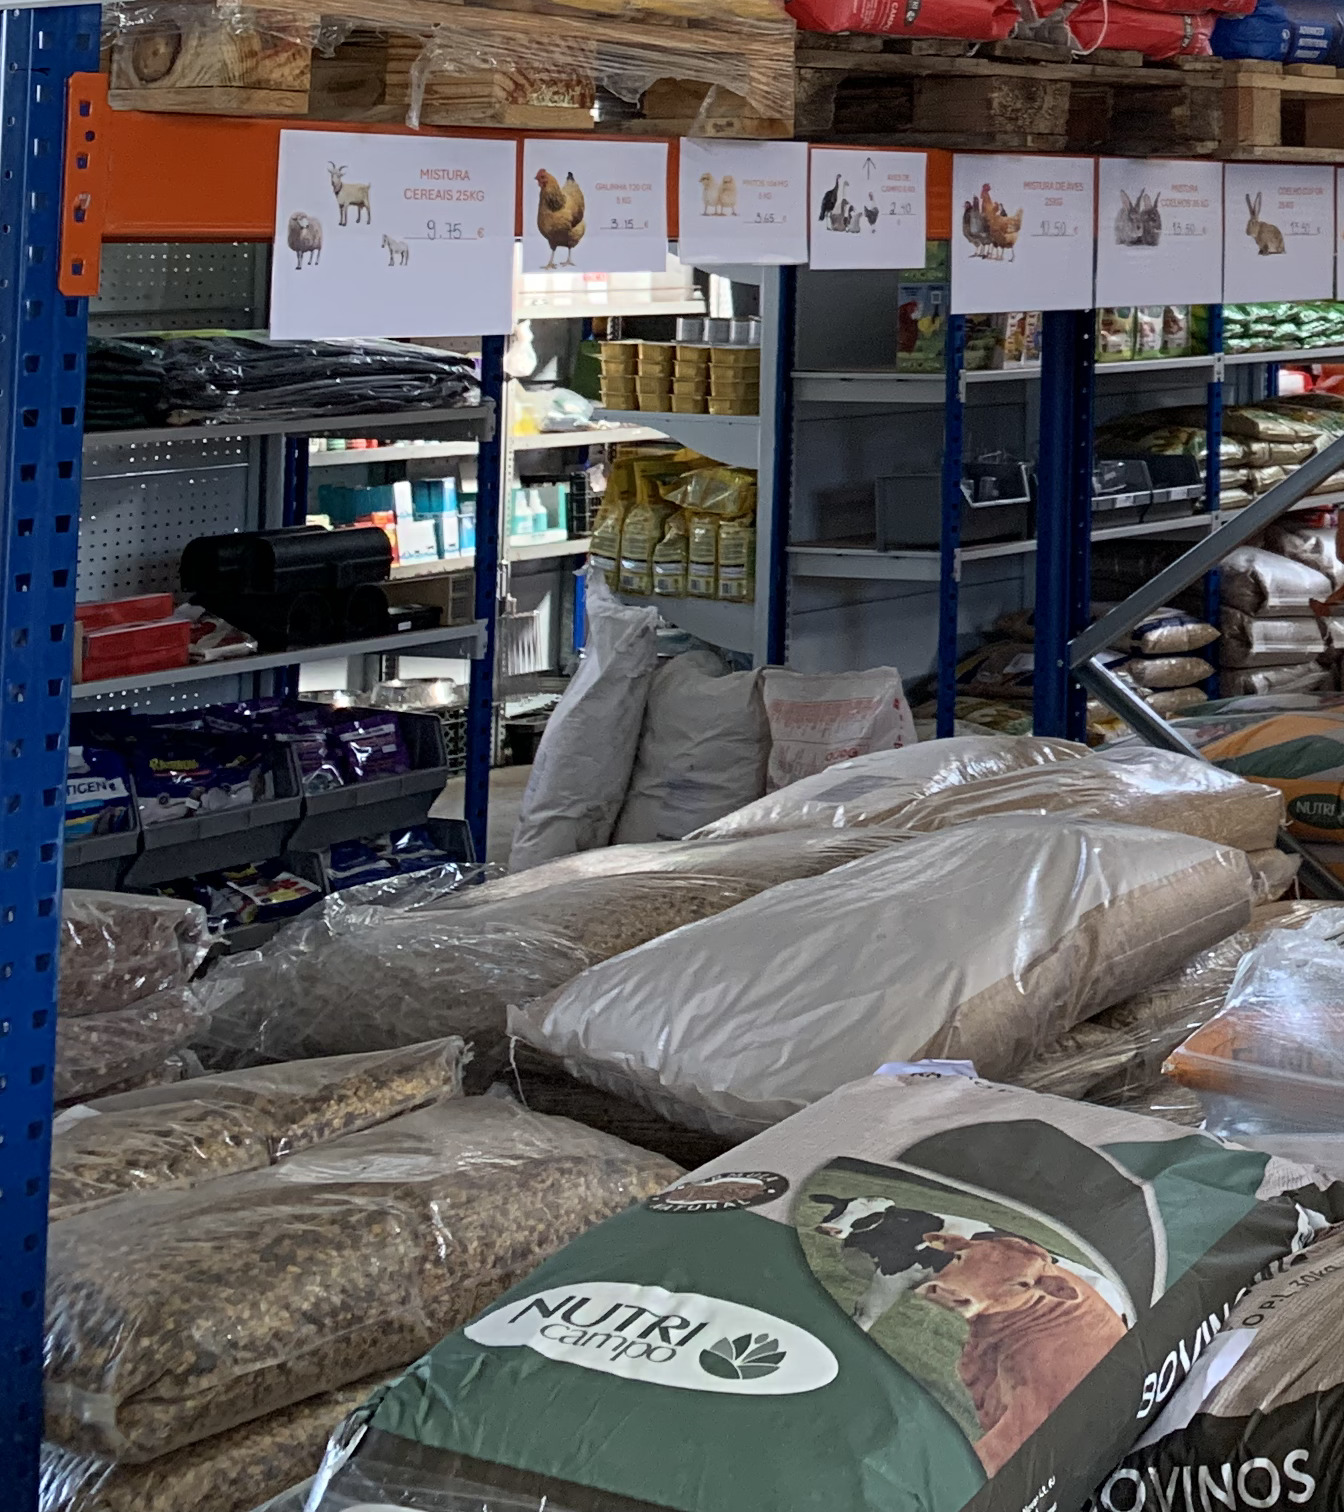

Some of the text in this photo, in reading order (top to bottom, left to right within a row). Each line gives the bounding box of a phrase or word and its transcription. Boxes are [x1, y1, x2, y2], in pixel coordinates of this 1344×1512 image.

[420, 169, 471, 182] MISTURA
[404, 189, 486, 203] CEREAIS 25KG
[1296, 800, 1335, 819] NUTRI
[508, 1295, 710, 1348] NUTRI
[539, 1323, 678, 1363] campo
[1076, 1449, 1317, 1512] OVINOS
